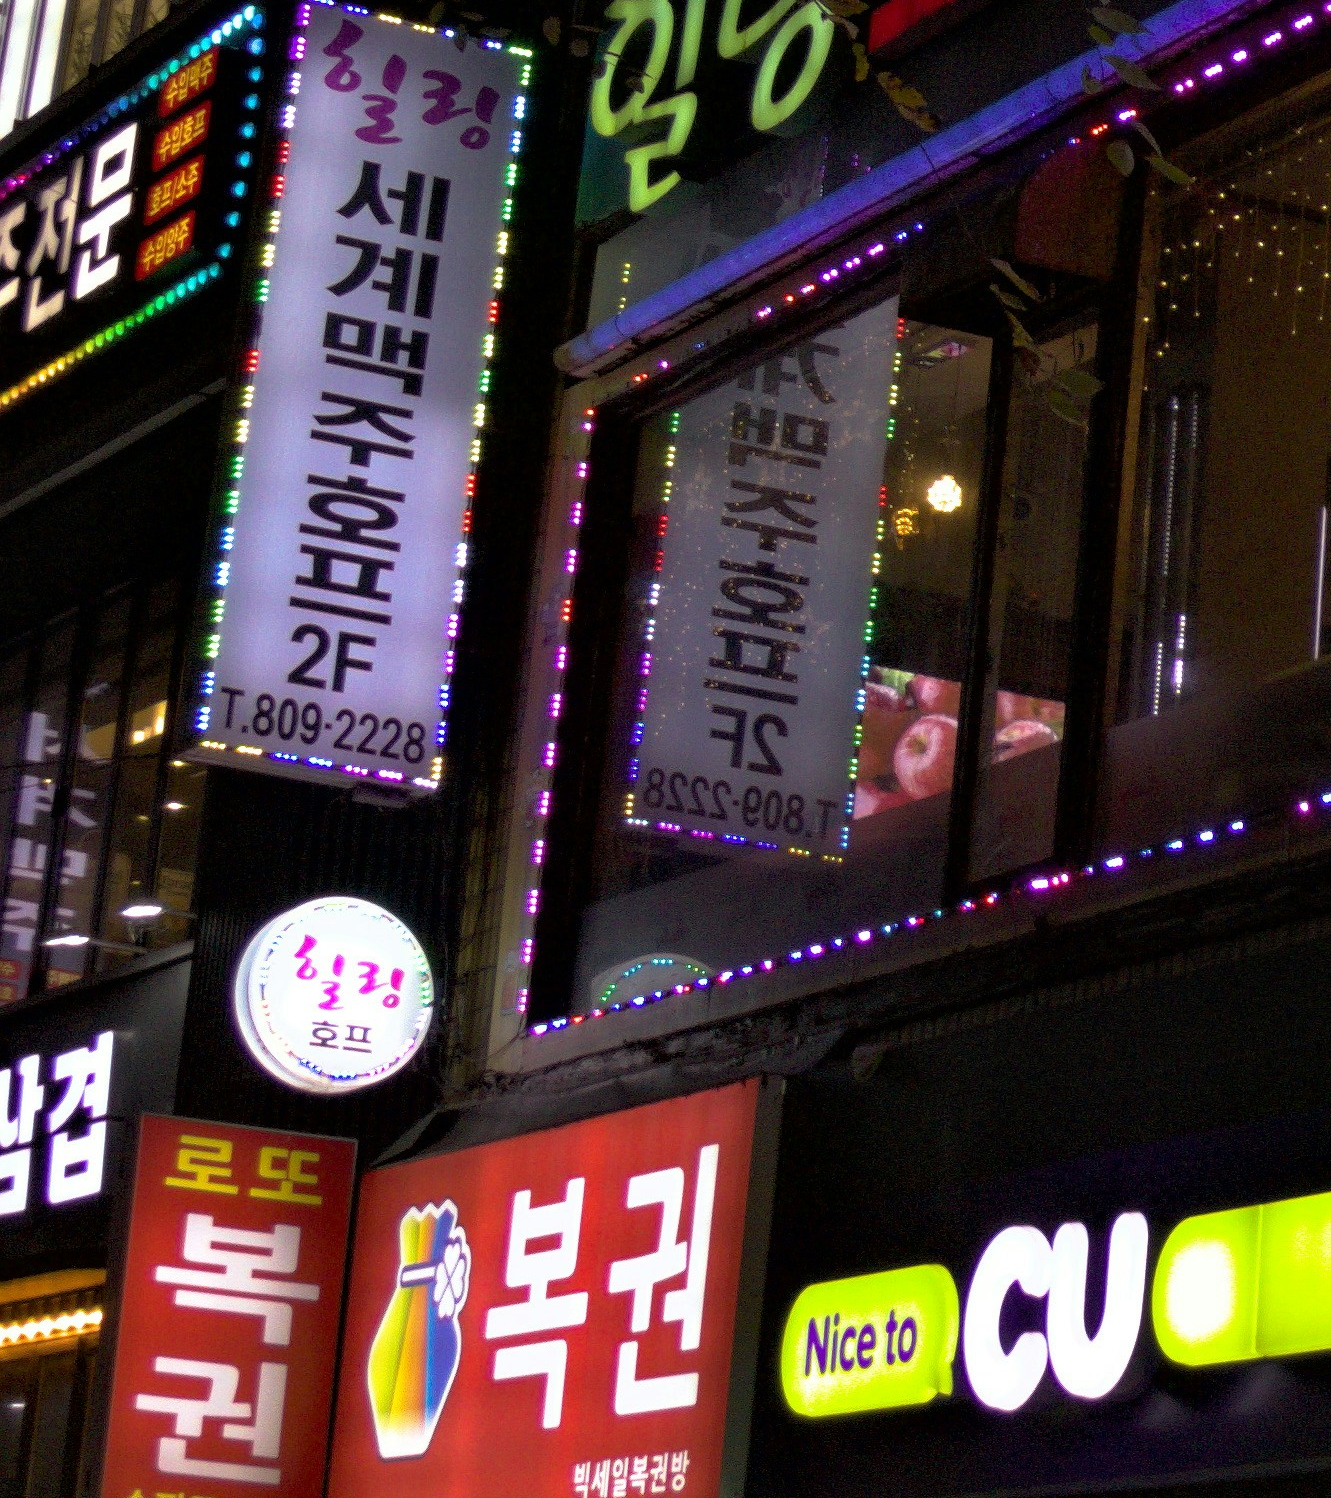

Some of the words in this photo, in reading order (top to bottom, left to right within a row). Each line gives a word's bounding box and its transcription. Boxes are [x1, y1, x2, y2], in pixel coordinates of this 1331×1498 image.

[320, 18, 502, 150] 힐링
[286, 624, 378, 694] 2F
[294, 934, 405, 1011] 힐링
[309, 1018, 373, 1054] 호프
[163, 1133, 324, 1207] 로또
[484, 1143, 720, 1431] 복권
[802, 1315, 876, 1377] Nice
[884, 1307, 918, 1366] to
[963, 1211, 1150, 1412] CU
[134, 1211, 322, 1486] 복권
